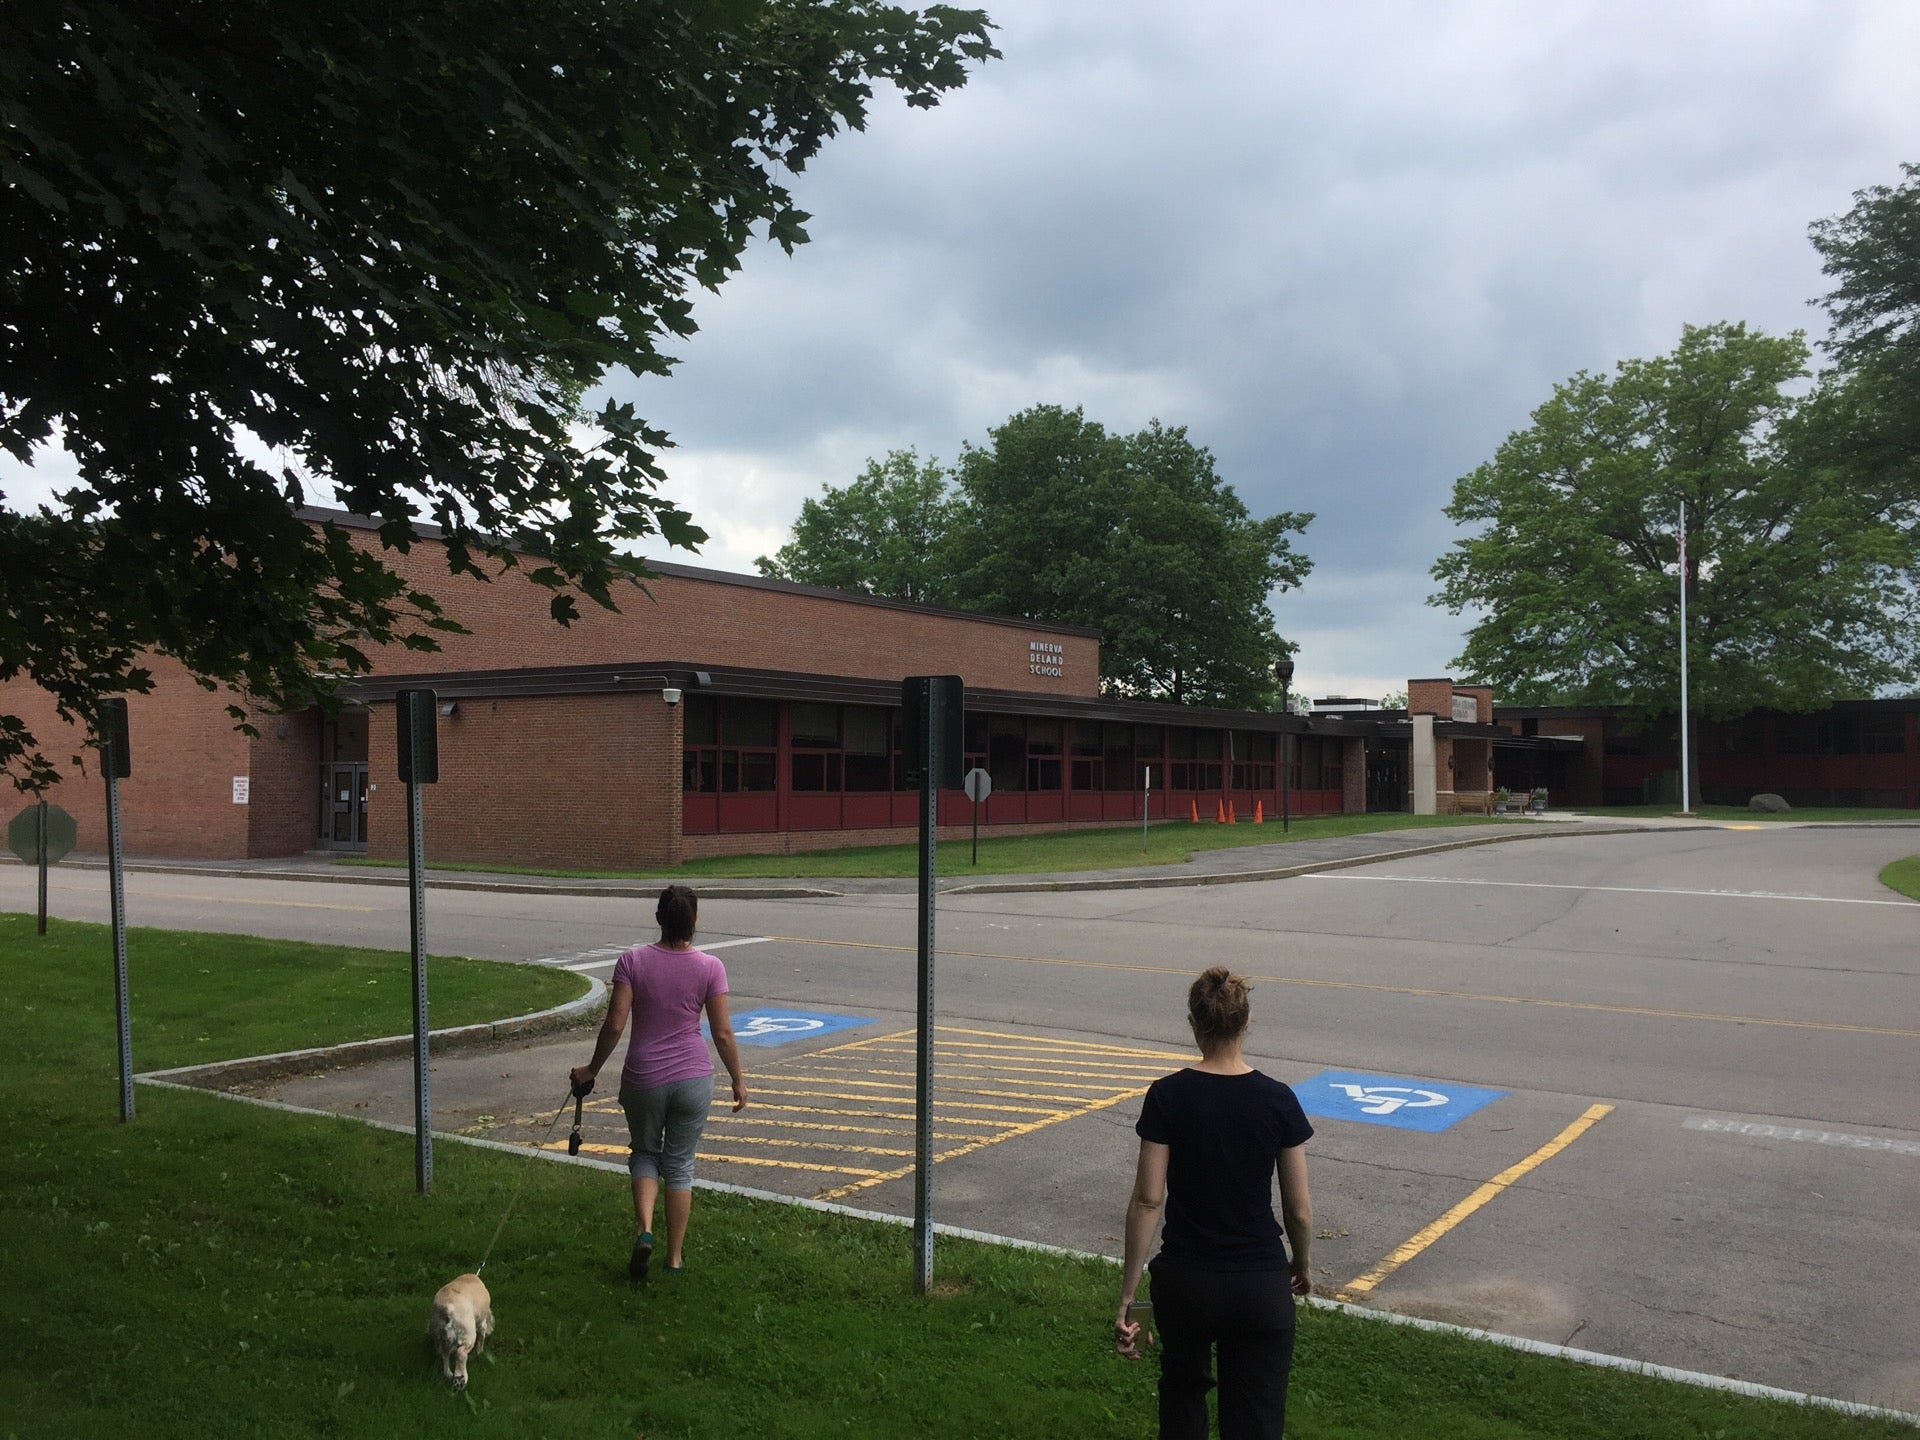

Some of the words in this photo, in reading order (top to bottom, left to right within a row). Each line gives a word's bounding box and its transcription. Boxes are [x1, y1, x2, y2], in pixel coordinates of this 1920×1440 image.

[1030, 641, 1063, 654] MINERVA
[1030, 653, 1064, 665] DELAND
[1029, 664, 1063, 677] SCHOOL
